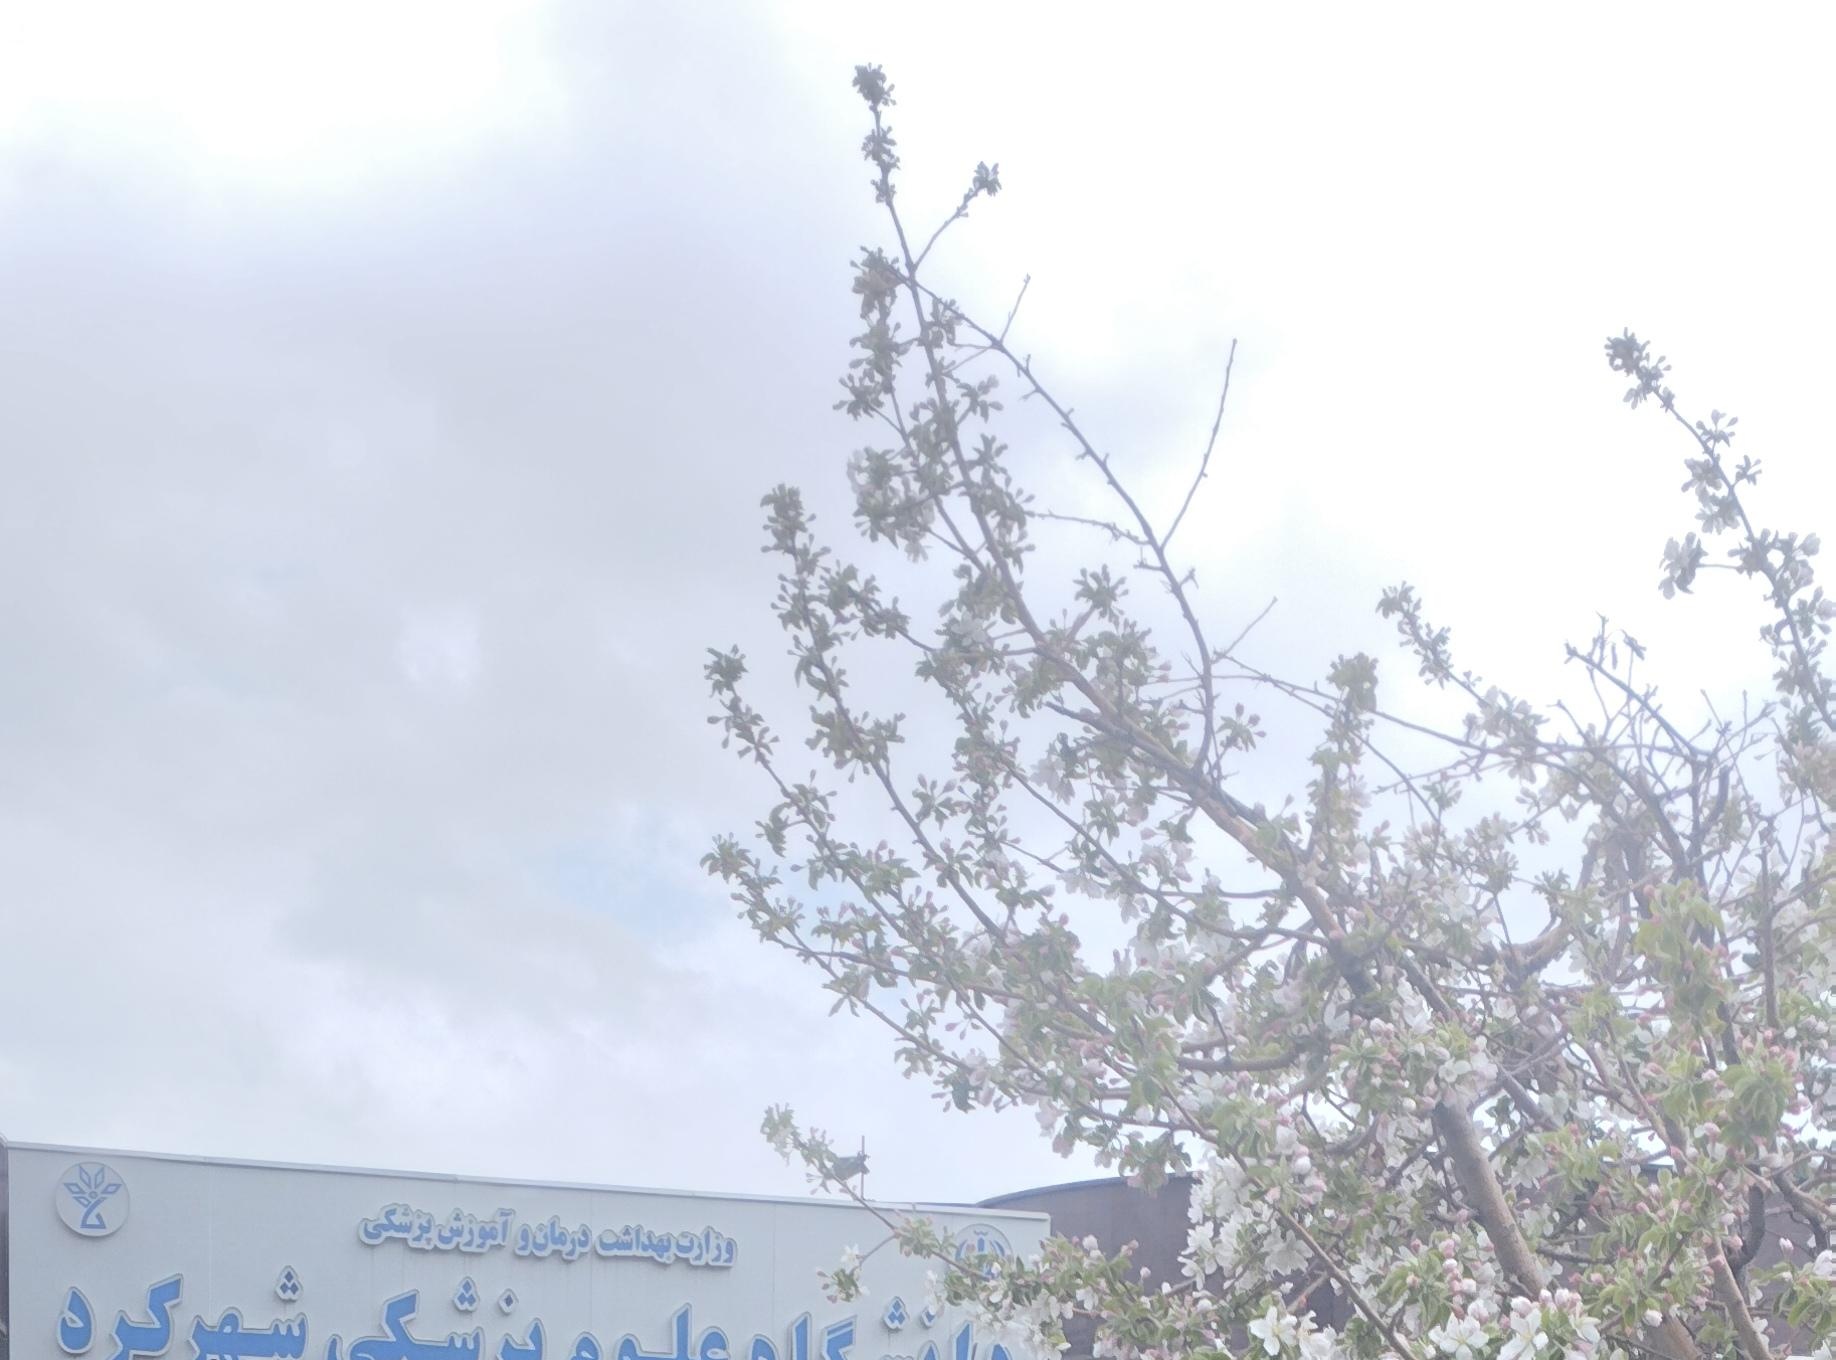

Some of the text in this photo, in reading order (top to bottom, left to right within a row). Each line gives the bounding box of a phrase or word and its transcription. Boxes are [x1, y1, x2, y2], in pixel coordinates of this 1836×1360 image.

[362, 1205, 735, 1264] وزارت بهداشت درمان و آموزش پزشکی
